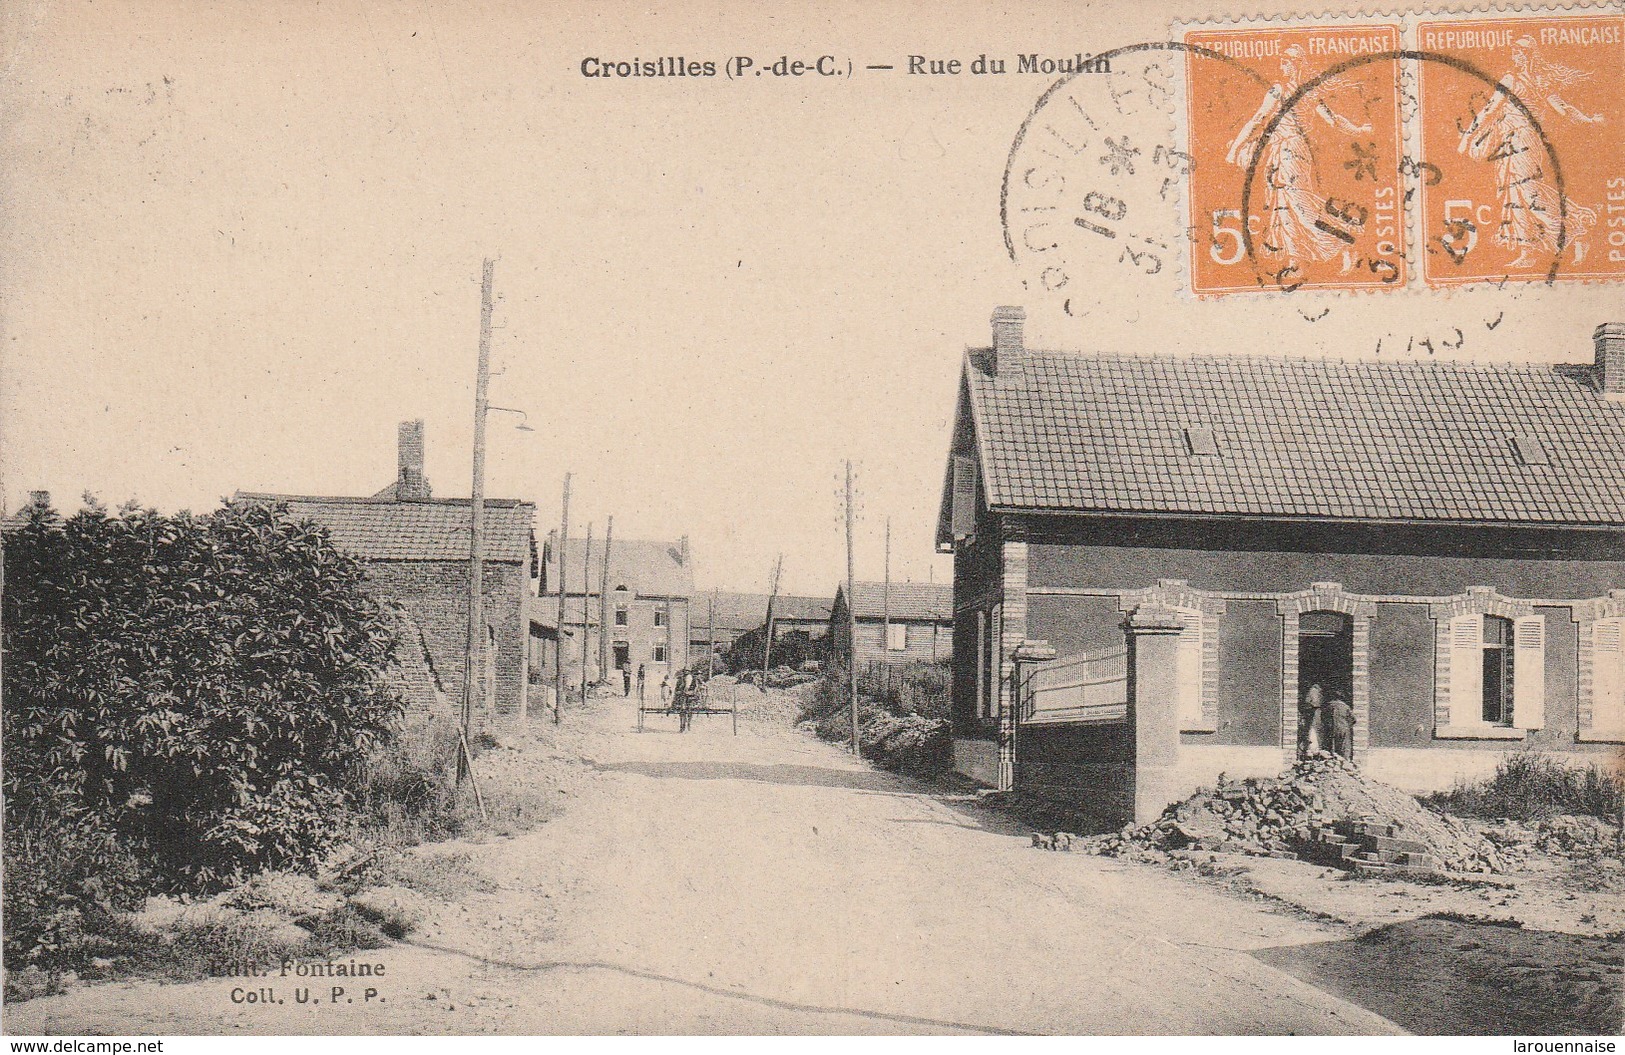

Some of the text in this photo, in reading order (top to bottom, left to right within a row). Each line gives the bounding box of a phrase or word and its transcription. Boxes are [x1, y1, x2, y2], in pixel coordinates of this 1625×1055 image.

[1308, 35, 1390, 55] FRANÇAISE
[1540, 25, 1621, 47] FRANÇAISE
[1606, 177, 1625, 262] POSTES
